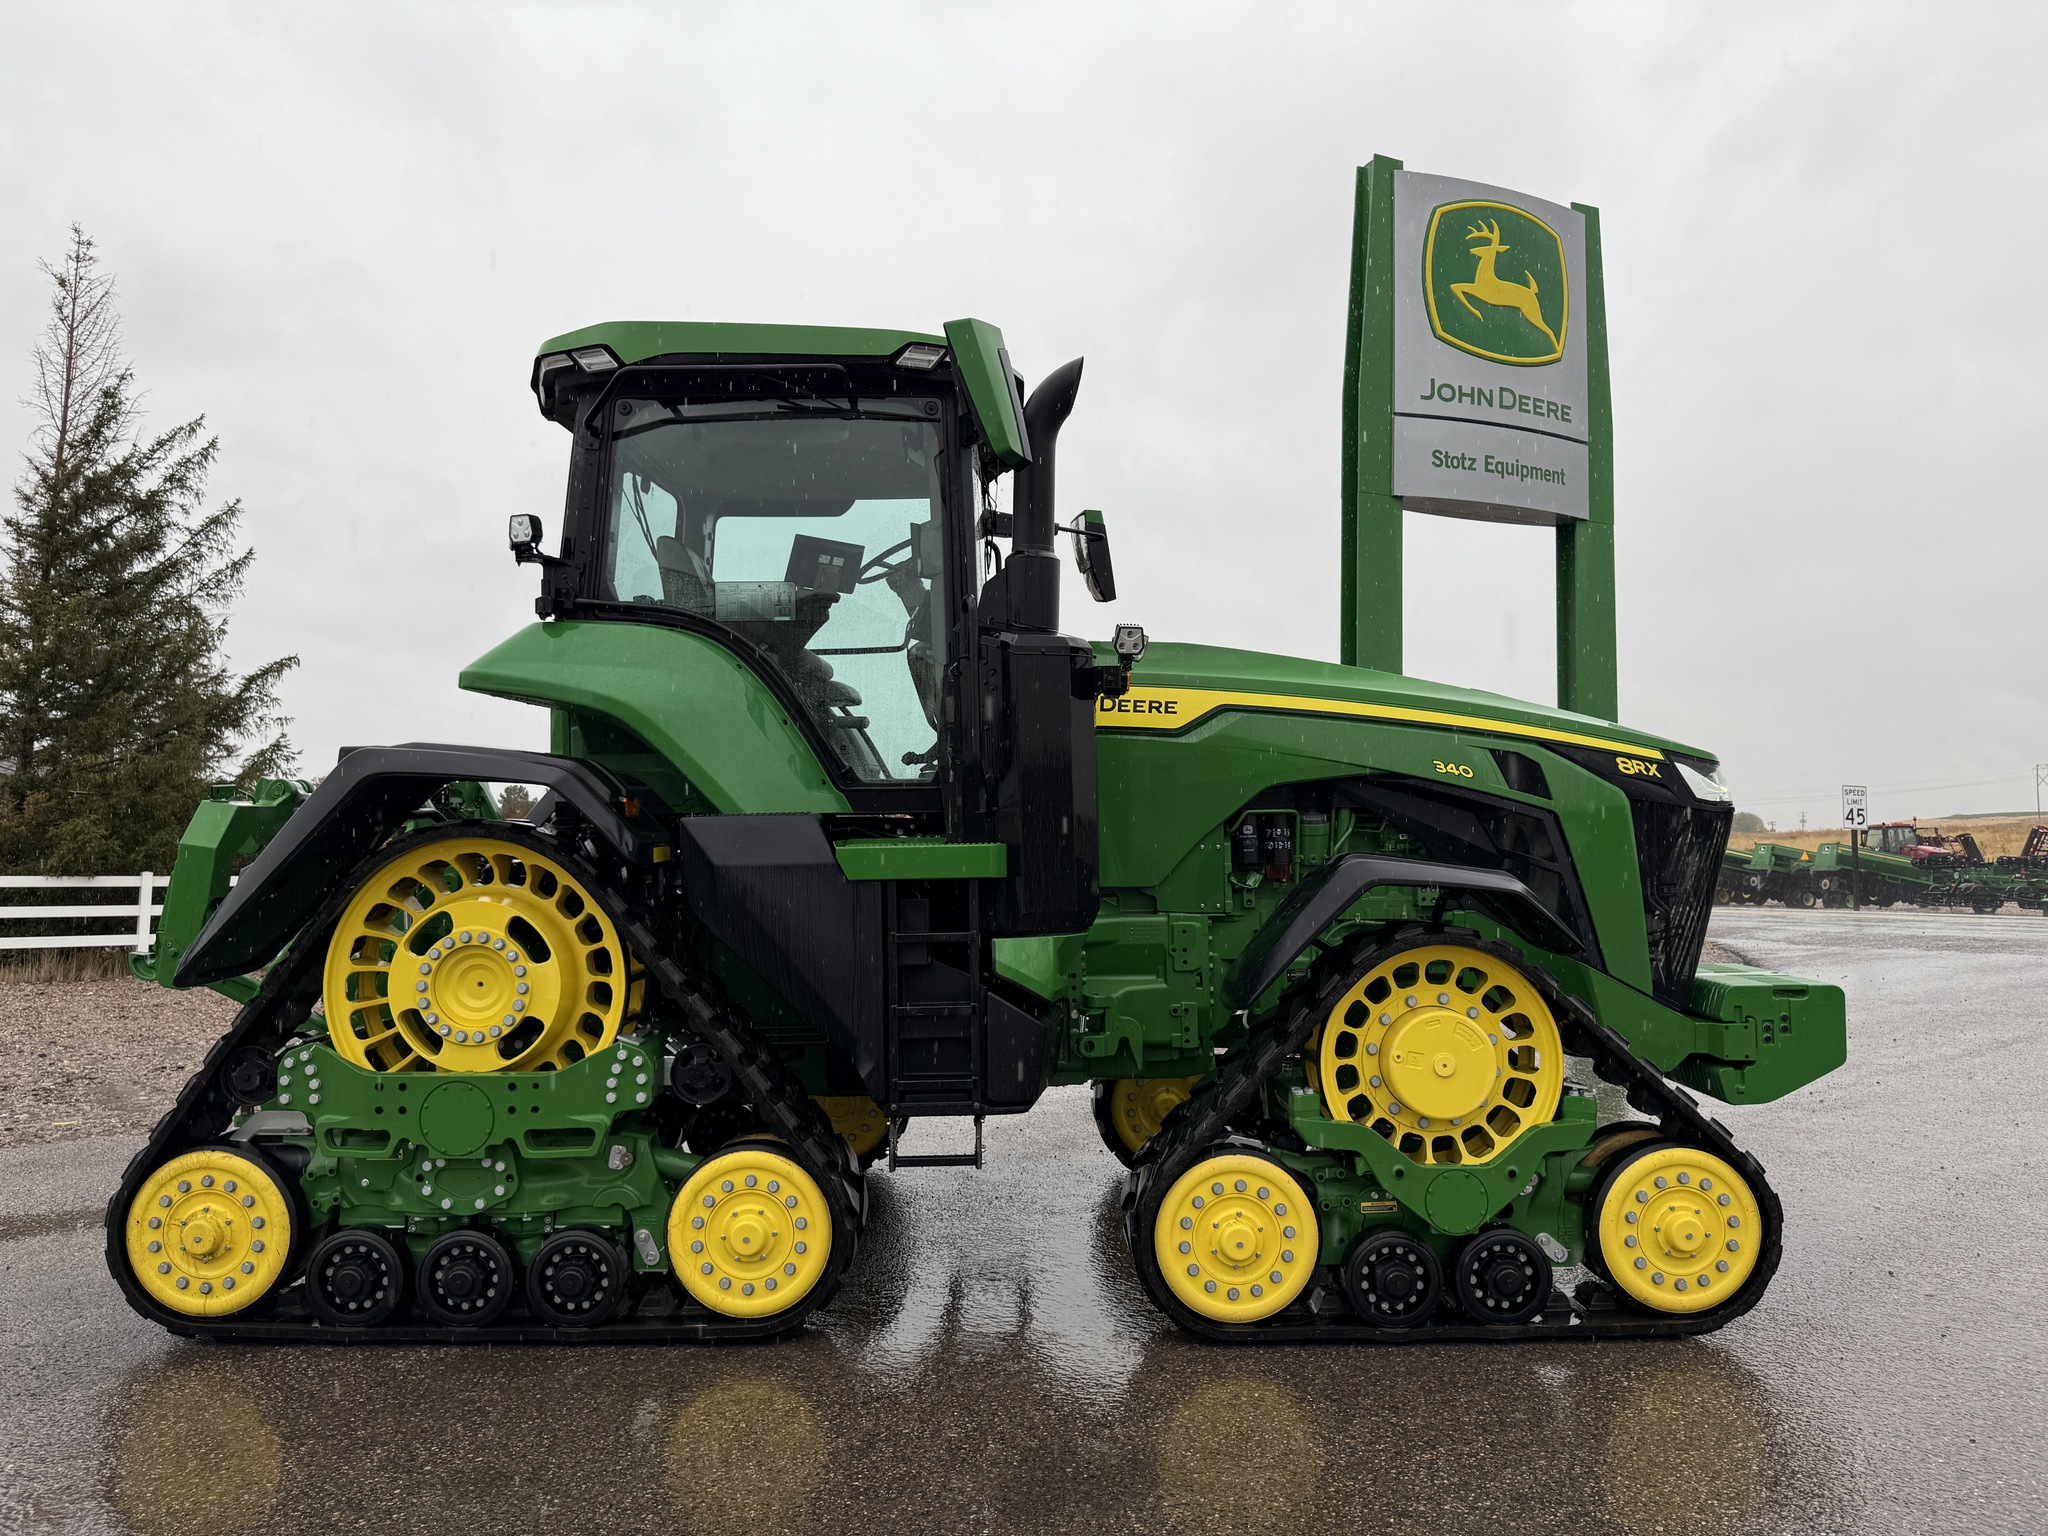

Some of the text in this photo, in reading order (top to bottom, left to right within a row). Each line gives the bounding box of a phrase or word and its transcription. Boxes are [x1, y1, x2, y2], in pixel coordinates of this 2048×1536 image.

[1420, 378, 1572, 424] JOHN DEERE
[1431, 449, 1566, 485] Stotz Equipment
[1100, 696, 1178, 714] DEERE
[1432, 760, 1474, 778] 340
[1615, 756, 1663, 778] 8RX
[1844, 788, 1866, 797] SPEED
[1846, 798, 1863, 806] LIMIT
[1845, 807, 1866, 825] 45
